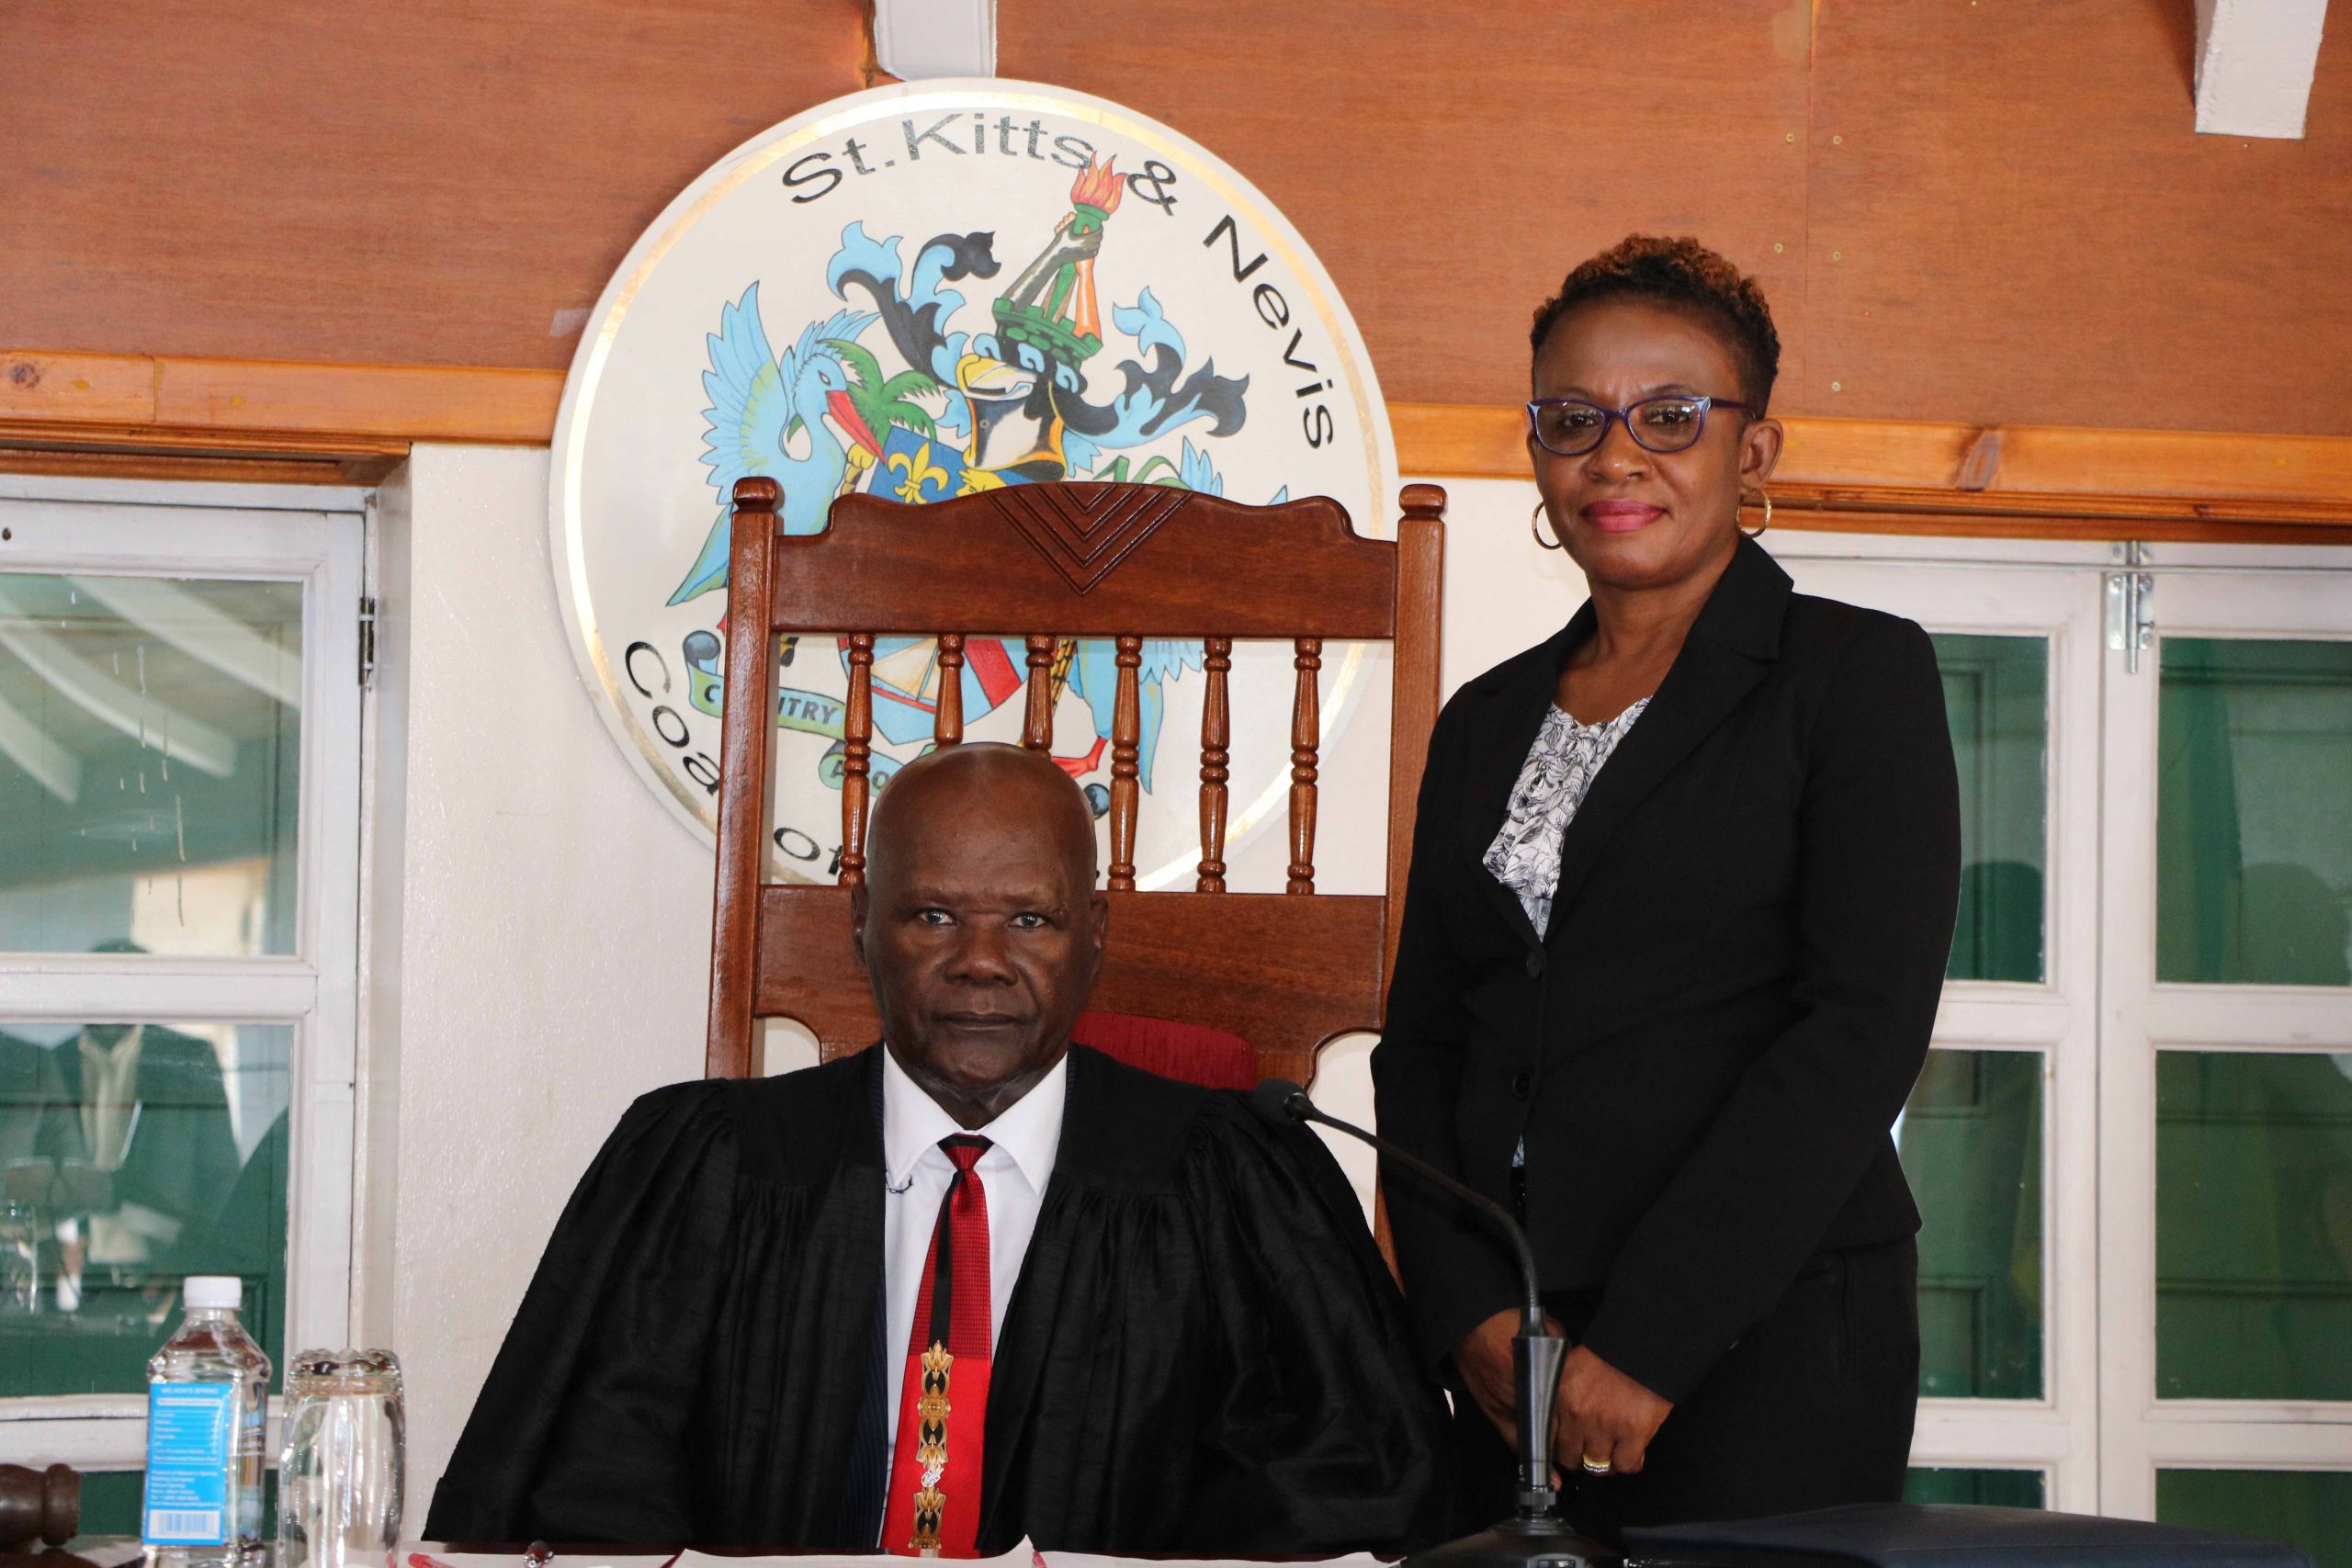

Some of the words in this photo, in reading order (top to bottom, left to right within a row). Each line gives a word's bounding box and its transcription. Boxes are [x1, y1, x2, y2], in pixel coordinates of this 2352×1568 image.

[1126, 160, 1178, 217] &
[1203, 214, 1334, 449] Nevis
[625, 641, 720, 795] Coa
